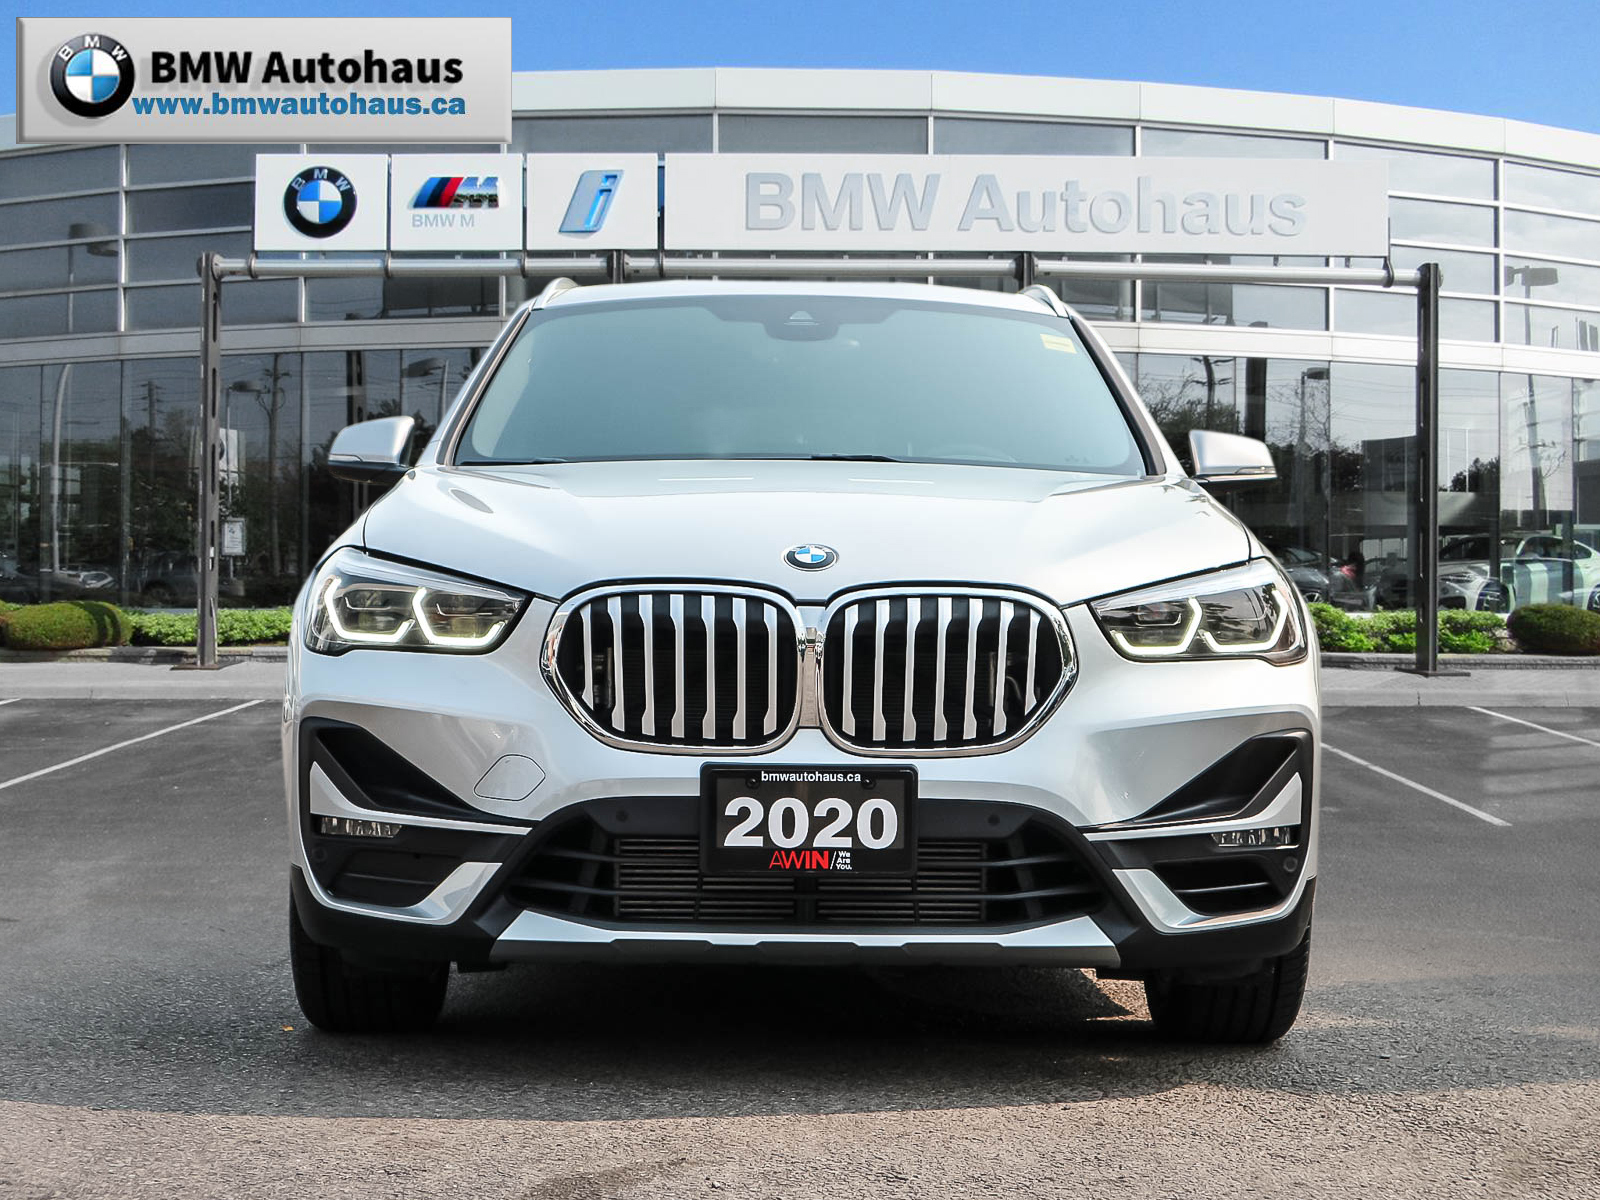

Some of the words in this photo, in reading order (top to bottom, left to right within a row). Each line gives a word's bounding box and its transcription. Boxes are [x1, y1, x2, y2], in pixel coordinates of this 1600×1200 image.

[291, 168, 351, 191] BMW
[745, 172, 940, 231] BMW
[958, 174, 1307, 236] Autohaus
[412, 214, 455, 227] BMW
[460, 214, 474, 227] M
[761, 771, 861, 782] bmwautohaus.ca
[723, 797, 898, 849] 2020
[769, 850, 829, 869] AWIN
